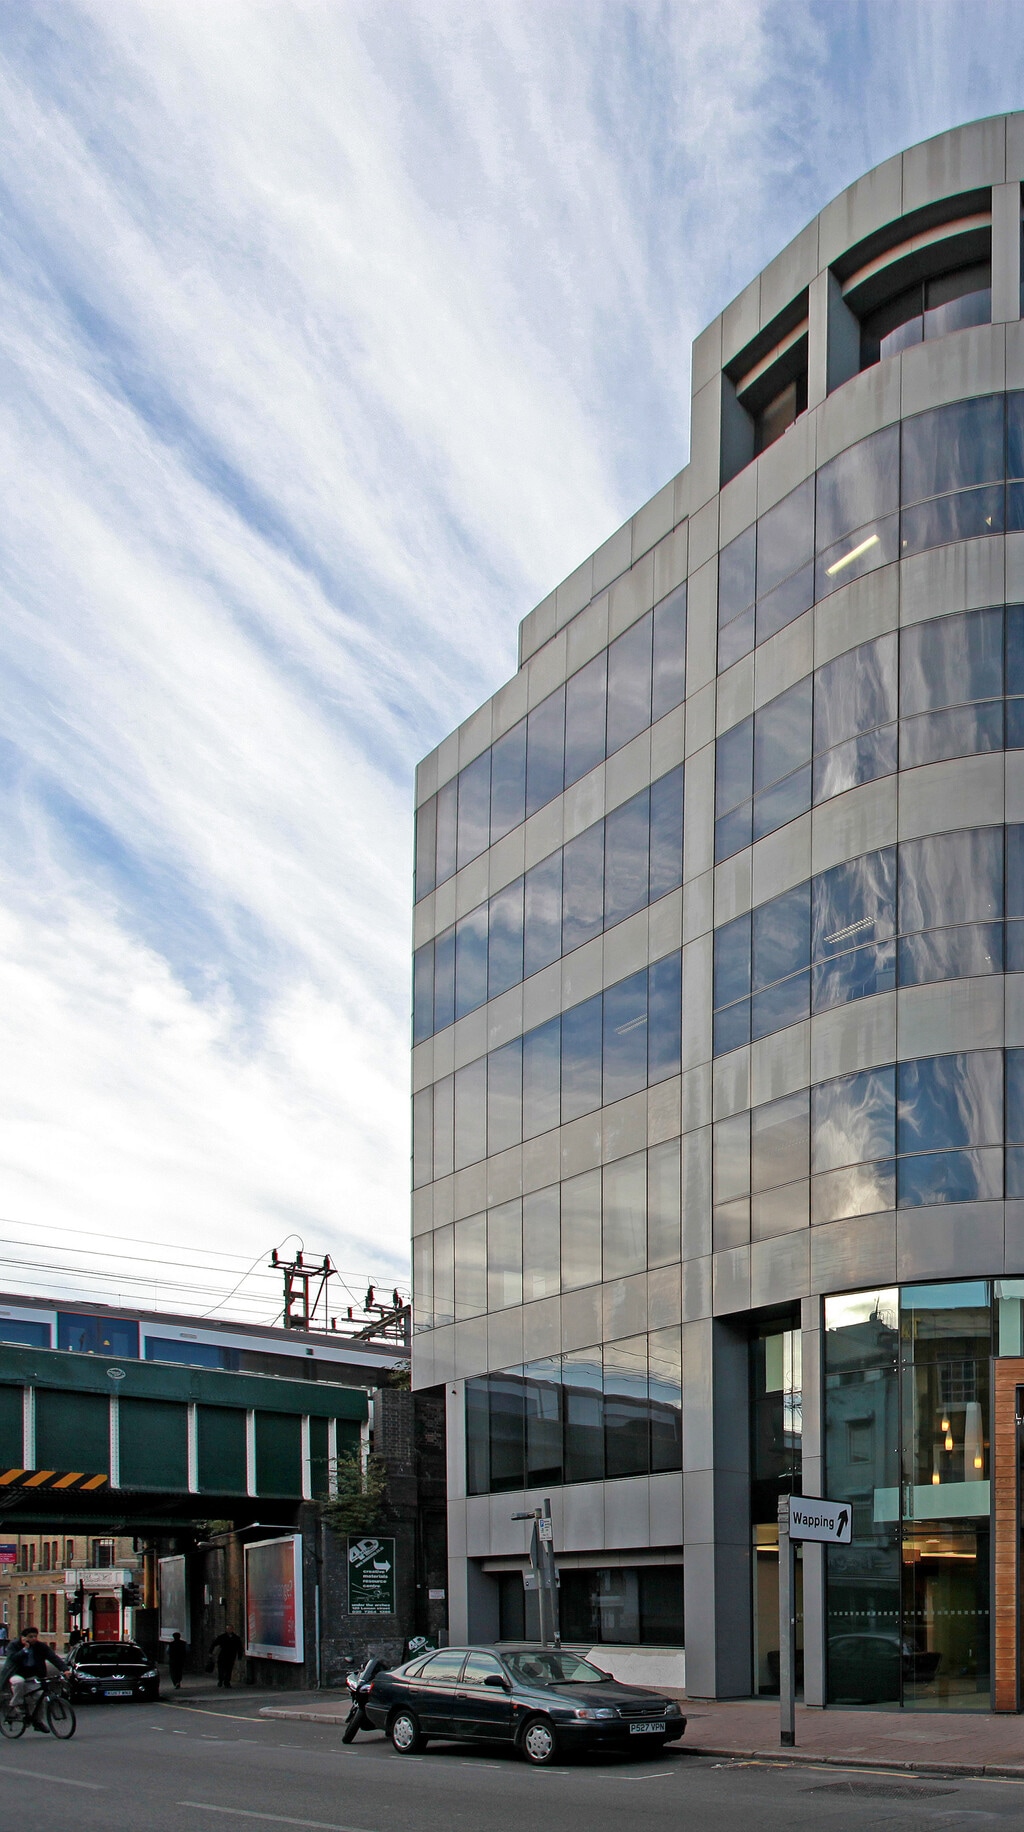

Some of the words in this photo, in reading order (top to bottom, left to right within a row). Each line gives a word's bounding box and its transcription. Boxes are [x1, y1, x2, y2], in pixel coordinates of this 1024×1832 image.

[793, 1511, 834, 1530] Wapping
[349, 1539, 379, 1563] 4D
[408, 1636, 426, 1650] 4D
[631, 1723, 650, 1732] P527
[651, 1722, 665, 1731] VPN
